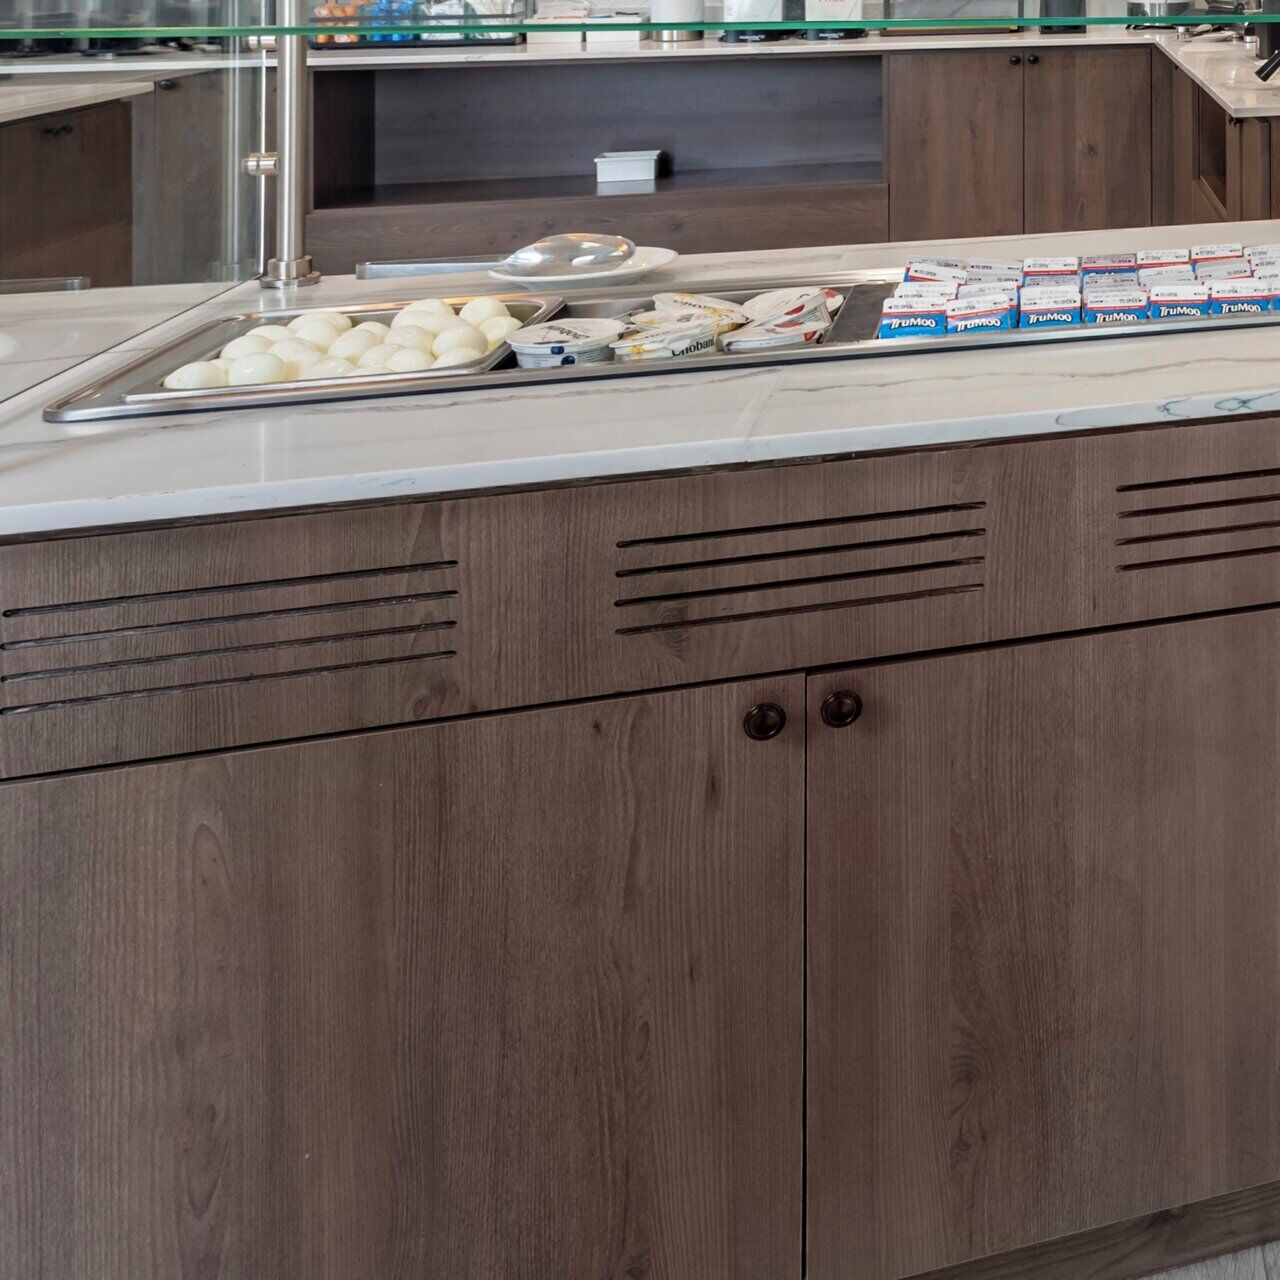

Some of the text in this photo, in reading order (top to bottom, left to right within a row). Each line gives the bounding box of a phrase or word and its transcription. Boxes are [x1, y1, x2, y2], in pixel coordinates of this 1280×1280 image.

[1160, 306, 1201, 317] TruMoo
[1221, 303, 1261, 314] TruMoo
[890, 317, 936, 329] TruMoo
[1028, 312, 1072, 324] TruMoo
[1095, 312, 1138, 323] TruMoo
[956, 318, 1002, 332] TruMoo
